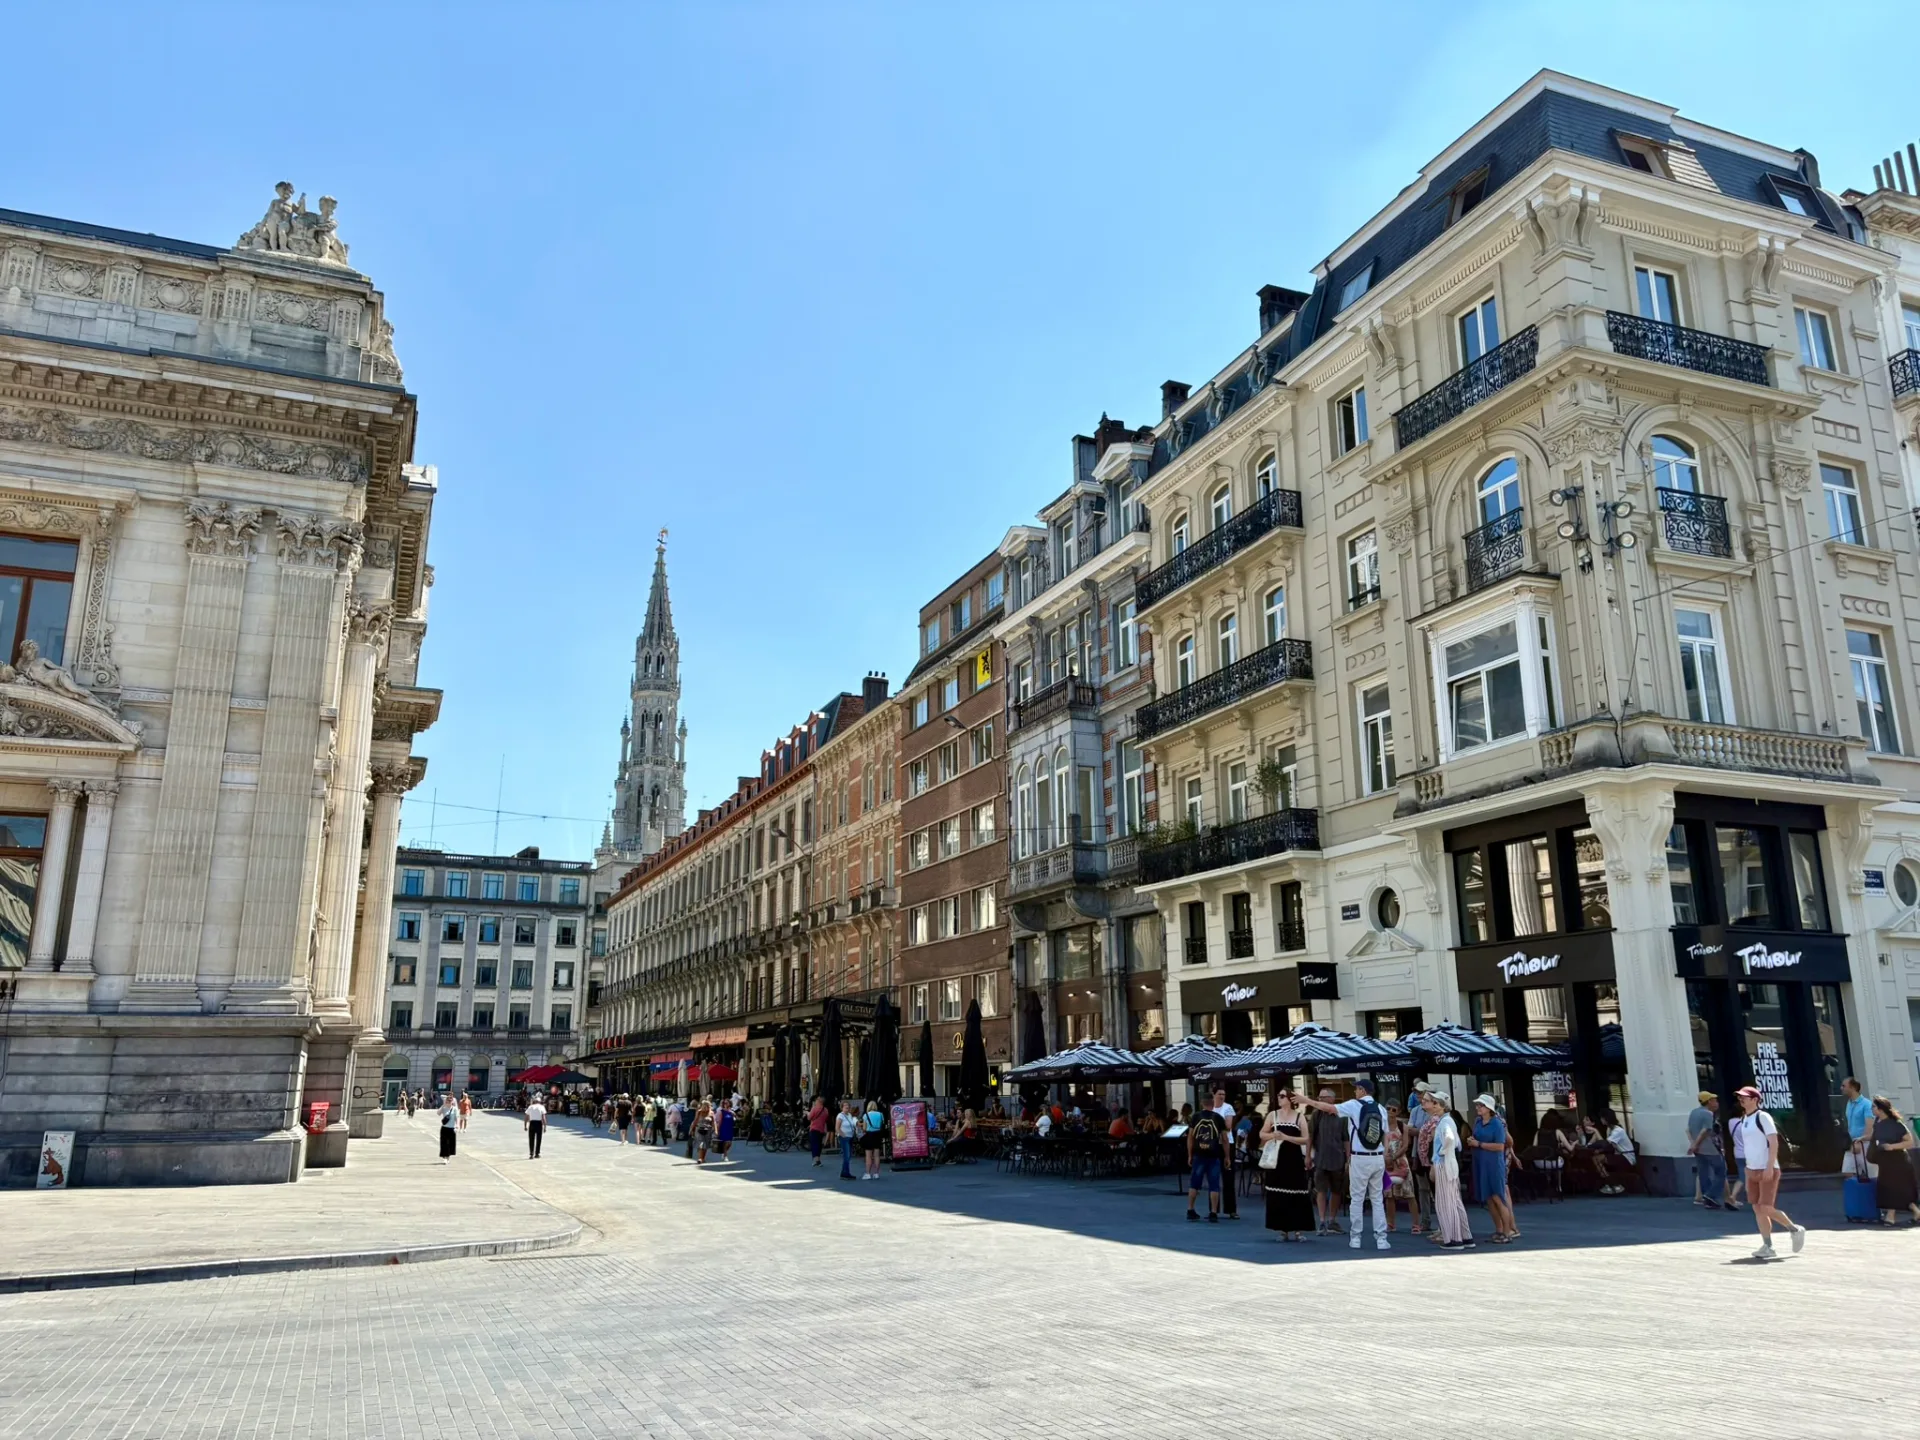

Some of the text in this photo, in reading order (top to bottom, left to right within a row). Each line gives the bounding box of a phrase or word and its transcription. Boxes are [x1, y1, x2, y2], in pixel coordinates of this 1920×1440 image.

[1757, 1042, 1779, 1058] FIRE
[1752, 1059, 1788, 1075] FUELED
[1755, 1076, 1790, 1091] SYRIAN
